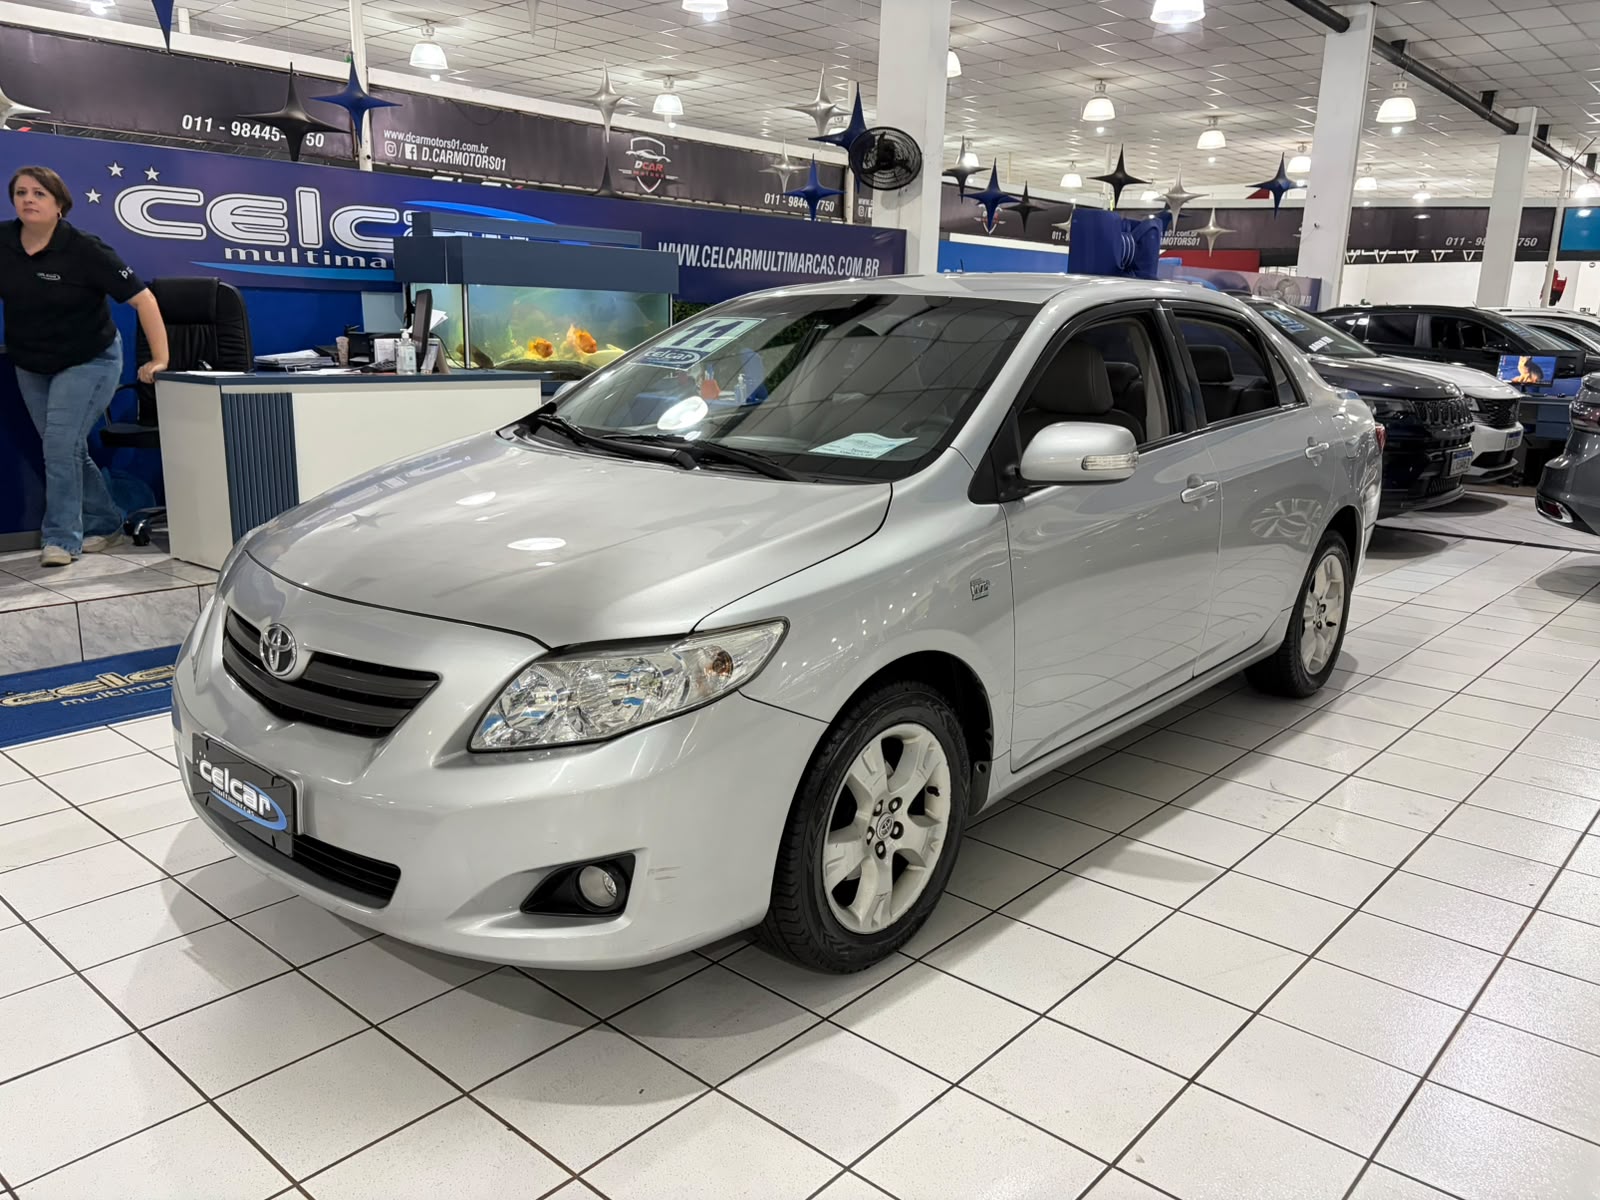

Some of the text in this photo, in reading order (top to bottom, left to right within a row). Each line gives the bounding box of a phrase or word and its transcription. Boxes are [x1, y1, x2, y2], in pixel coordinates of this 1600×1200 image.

[182, 114, 213, 132] 011
[231, 121, 325, 148] 98445-50
[384, 129, 488, 154] www.dcarmotors01.com.br
[421, 147, 507, 171] D.CARMOTORS01
[634, 160, 664, 172] DCAR
[764, 192, 780, 205] 011
[114, 184, 412, 254] celc
[1445, 237, 1465, 246] 011
[224, 247, 387, 269] multima
[672, 320, 743, 348] 11
[199, 759, 271, 816] celcar
